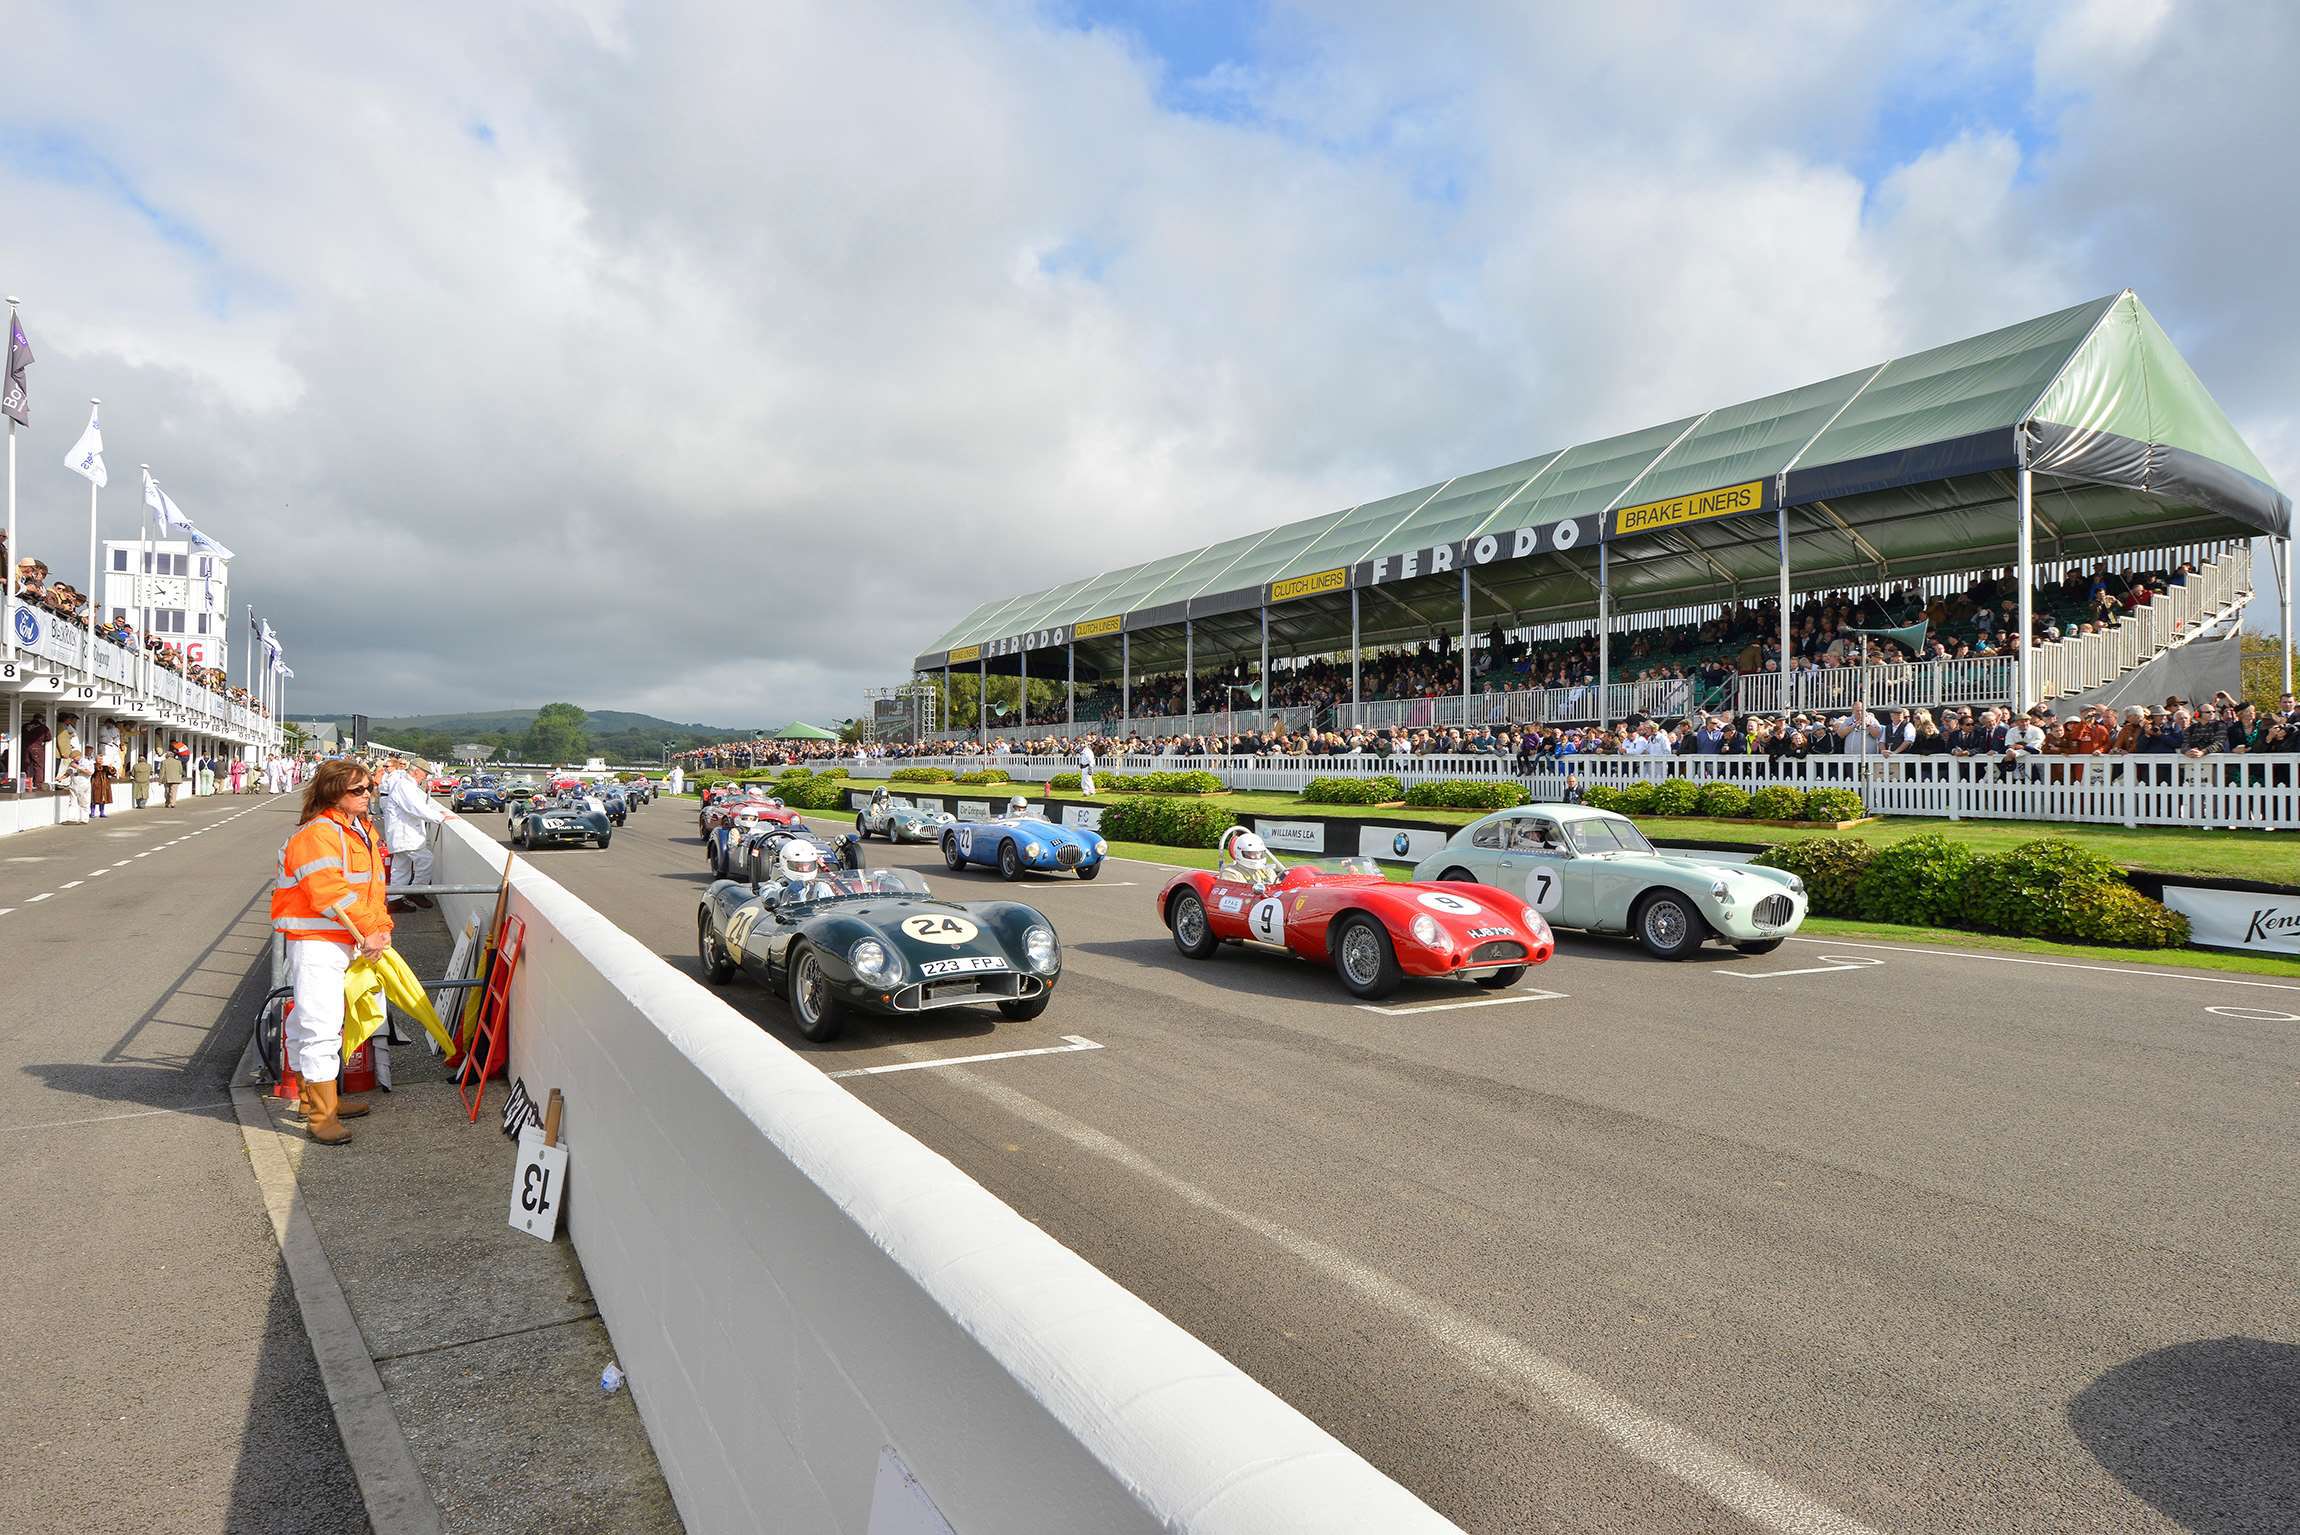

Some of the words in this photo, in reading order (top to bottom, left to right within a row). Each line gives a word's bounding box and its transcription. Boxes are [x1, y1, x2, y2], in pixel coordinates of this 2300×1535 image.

[1625, 502, 1683, 528] BRAKE
[1688, 489, 1751, 514] LINERS
[1371, 519, 1580, 584] FERODO
[1273, 581, 1308, 598] CLUTCH
[1310, 572, 1343, 590] LINERS
[1076, 624, 1098, 636] CLUTCH
[1098, 618, 1119, 632] LINERS
[988, 627, 1064, 658] FERODO
[4, 664, 15, 678] 8
[50, 677, 59, 688] 9
[78, 687, 93, 698] 10
[113, 696, 121, 705] 11
[131, 703, 143, 712] 12
[159, 710, 170, 719] 14
[189, 719, 199, 727] 16
[201, 721, 209, 729] 17
[211, 724, 220, 732] 18
[961, 829, 970, 849] 22
[1271, 828, 1302, 838] WILLIAMS
[1302, 830, 1315, 839] LEA
[1537, 874, 1551, 904] 7
[1434, 896, 1464, 909] 9
[727, 911, 753, 944] 24
[912, 918, 963, 936] 24
[1261, 904, 1274, 934] 9
[924, 960, 960, 976] 223
[970, 956, 1005, 970] FPJ
[521, 1163, 551, 1215] 13
